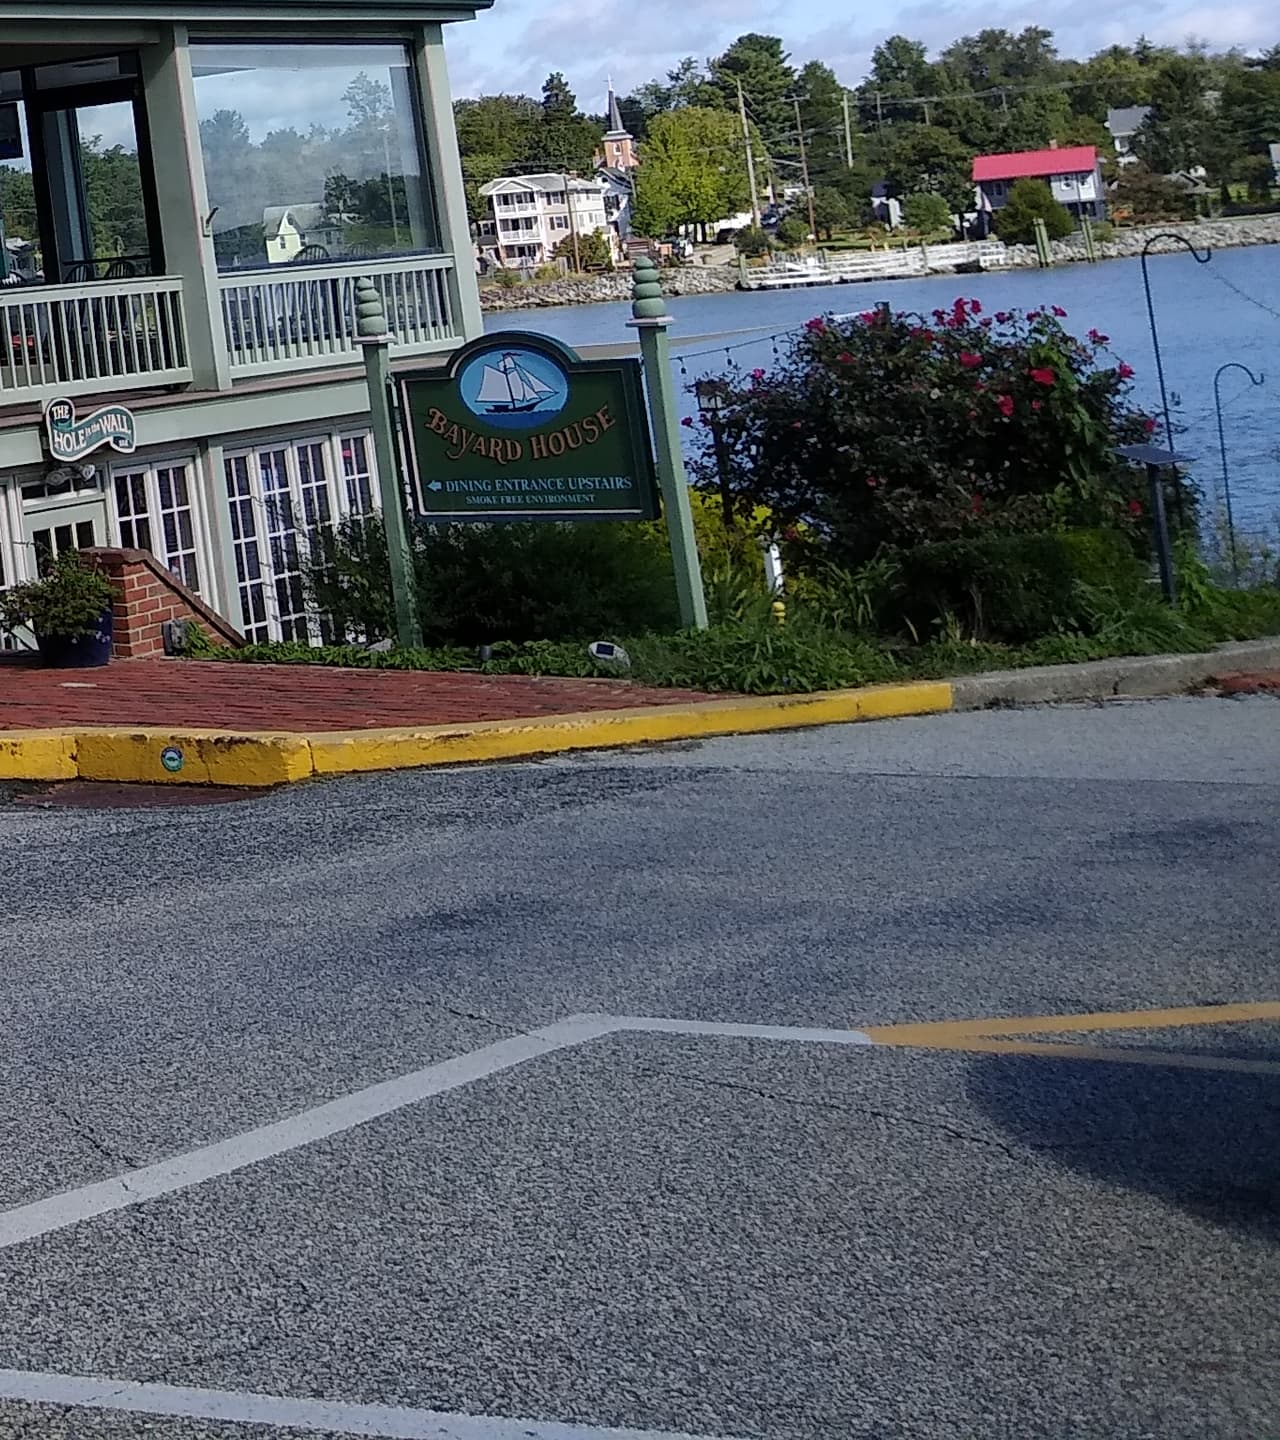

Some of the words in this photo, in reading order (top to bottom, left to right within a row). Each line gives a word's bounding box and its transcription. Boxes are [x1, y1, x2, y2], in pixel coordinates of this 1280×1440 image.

[51, 404, 70, 419] THE
[53, 429, 87, 452] HOLE
[99, 413, 132, 434] WALL
[424, 407, 522, 465] BAYARD
[530, 404, 616, 460] HOUSE
[445, 479, 492, 492] DINING
[495, 478, 565, 491] ENTRANCE
[569, 476, 632, 490] UPSTAIRS
[465, 495, 497, 505] SMOKE
[500, 495, 524, 504] FREE
[526, 494, 596, 505] ENVIRONMENT
